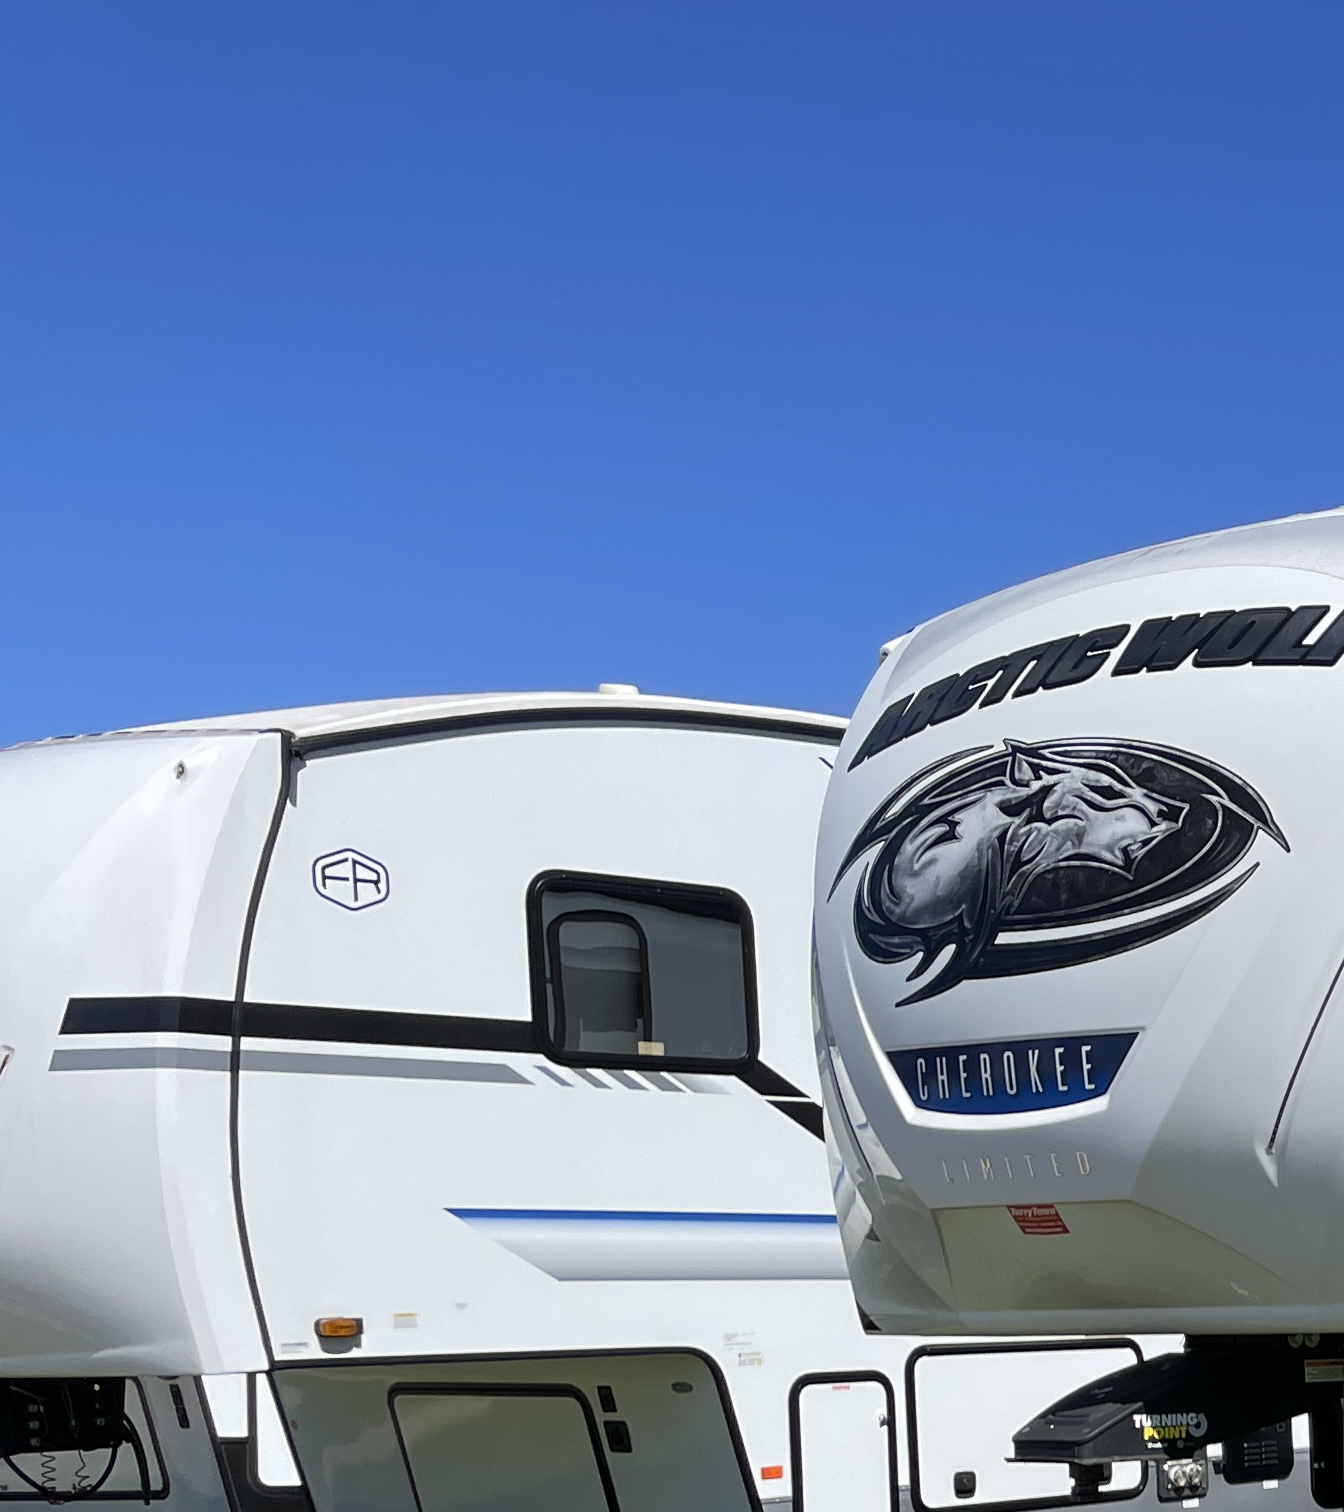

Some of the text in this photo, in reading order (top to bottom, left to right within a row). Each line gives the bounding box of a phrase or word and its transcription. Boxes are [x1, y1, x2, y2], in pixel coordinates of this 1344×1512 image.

[848, 624, 1130, 772] ARCTIC
[916, 1045, 1096, 1101] CHEROKEE
[942, 1151, 1090, 1183] LIMITED
[1132, 1412, 1198, 1428] TURNING
[1143, 1425, 1187, 1440] POINT
